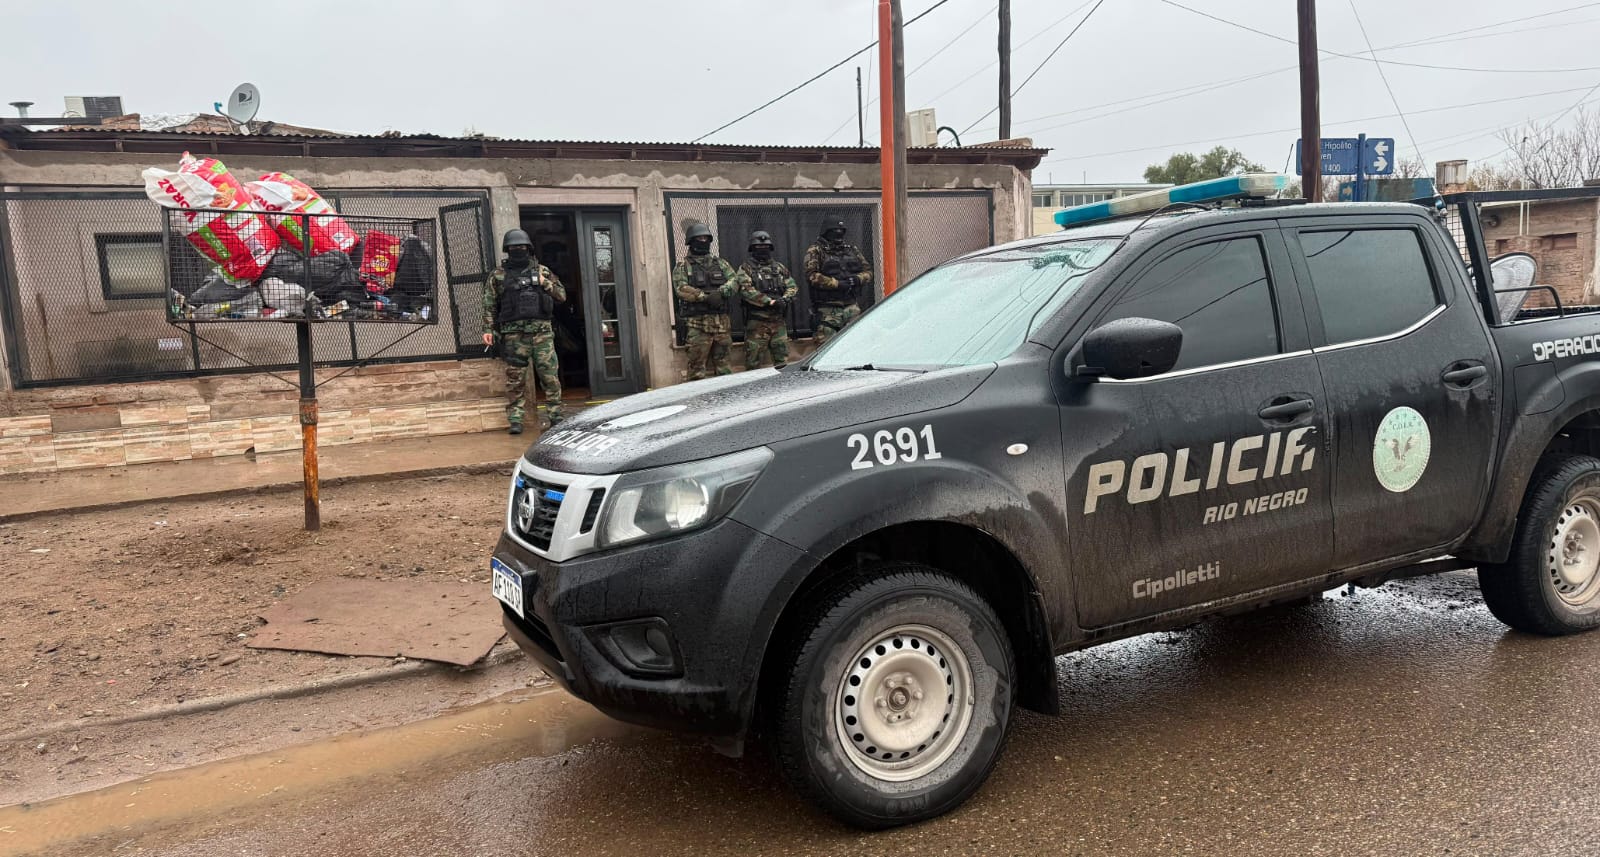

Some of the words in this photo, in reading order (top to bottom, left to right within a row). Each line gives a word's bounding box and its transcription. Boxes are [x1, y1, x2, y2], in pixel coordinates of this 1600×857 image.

[1324, 163, 1341, 173] 1400
[846, 424, 942, 470] 2691
[1083, 426, 1317, 515] POLICIA
[1202, 502, 1238, 525] RIO
[1242, 487, 1309, 517] NEGRO
[1132, 561, 1220, 599] Cipolletti
